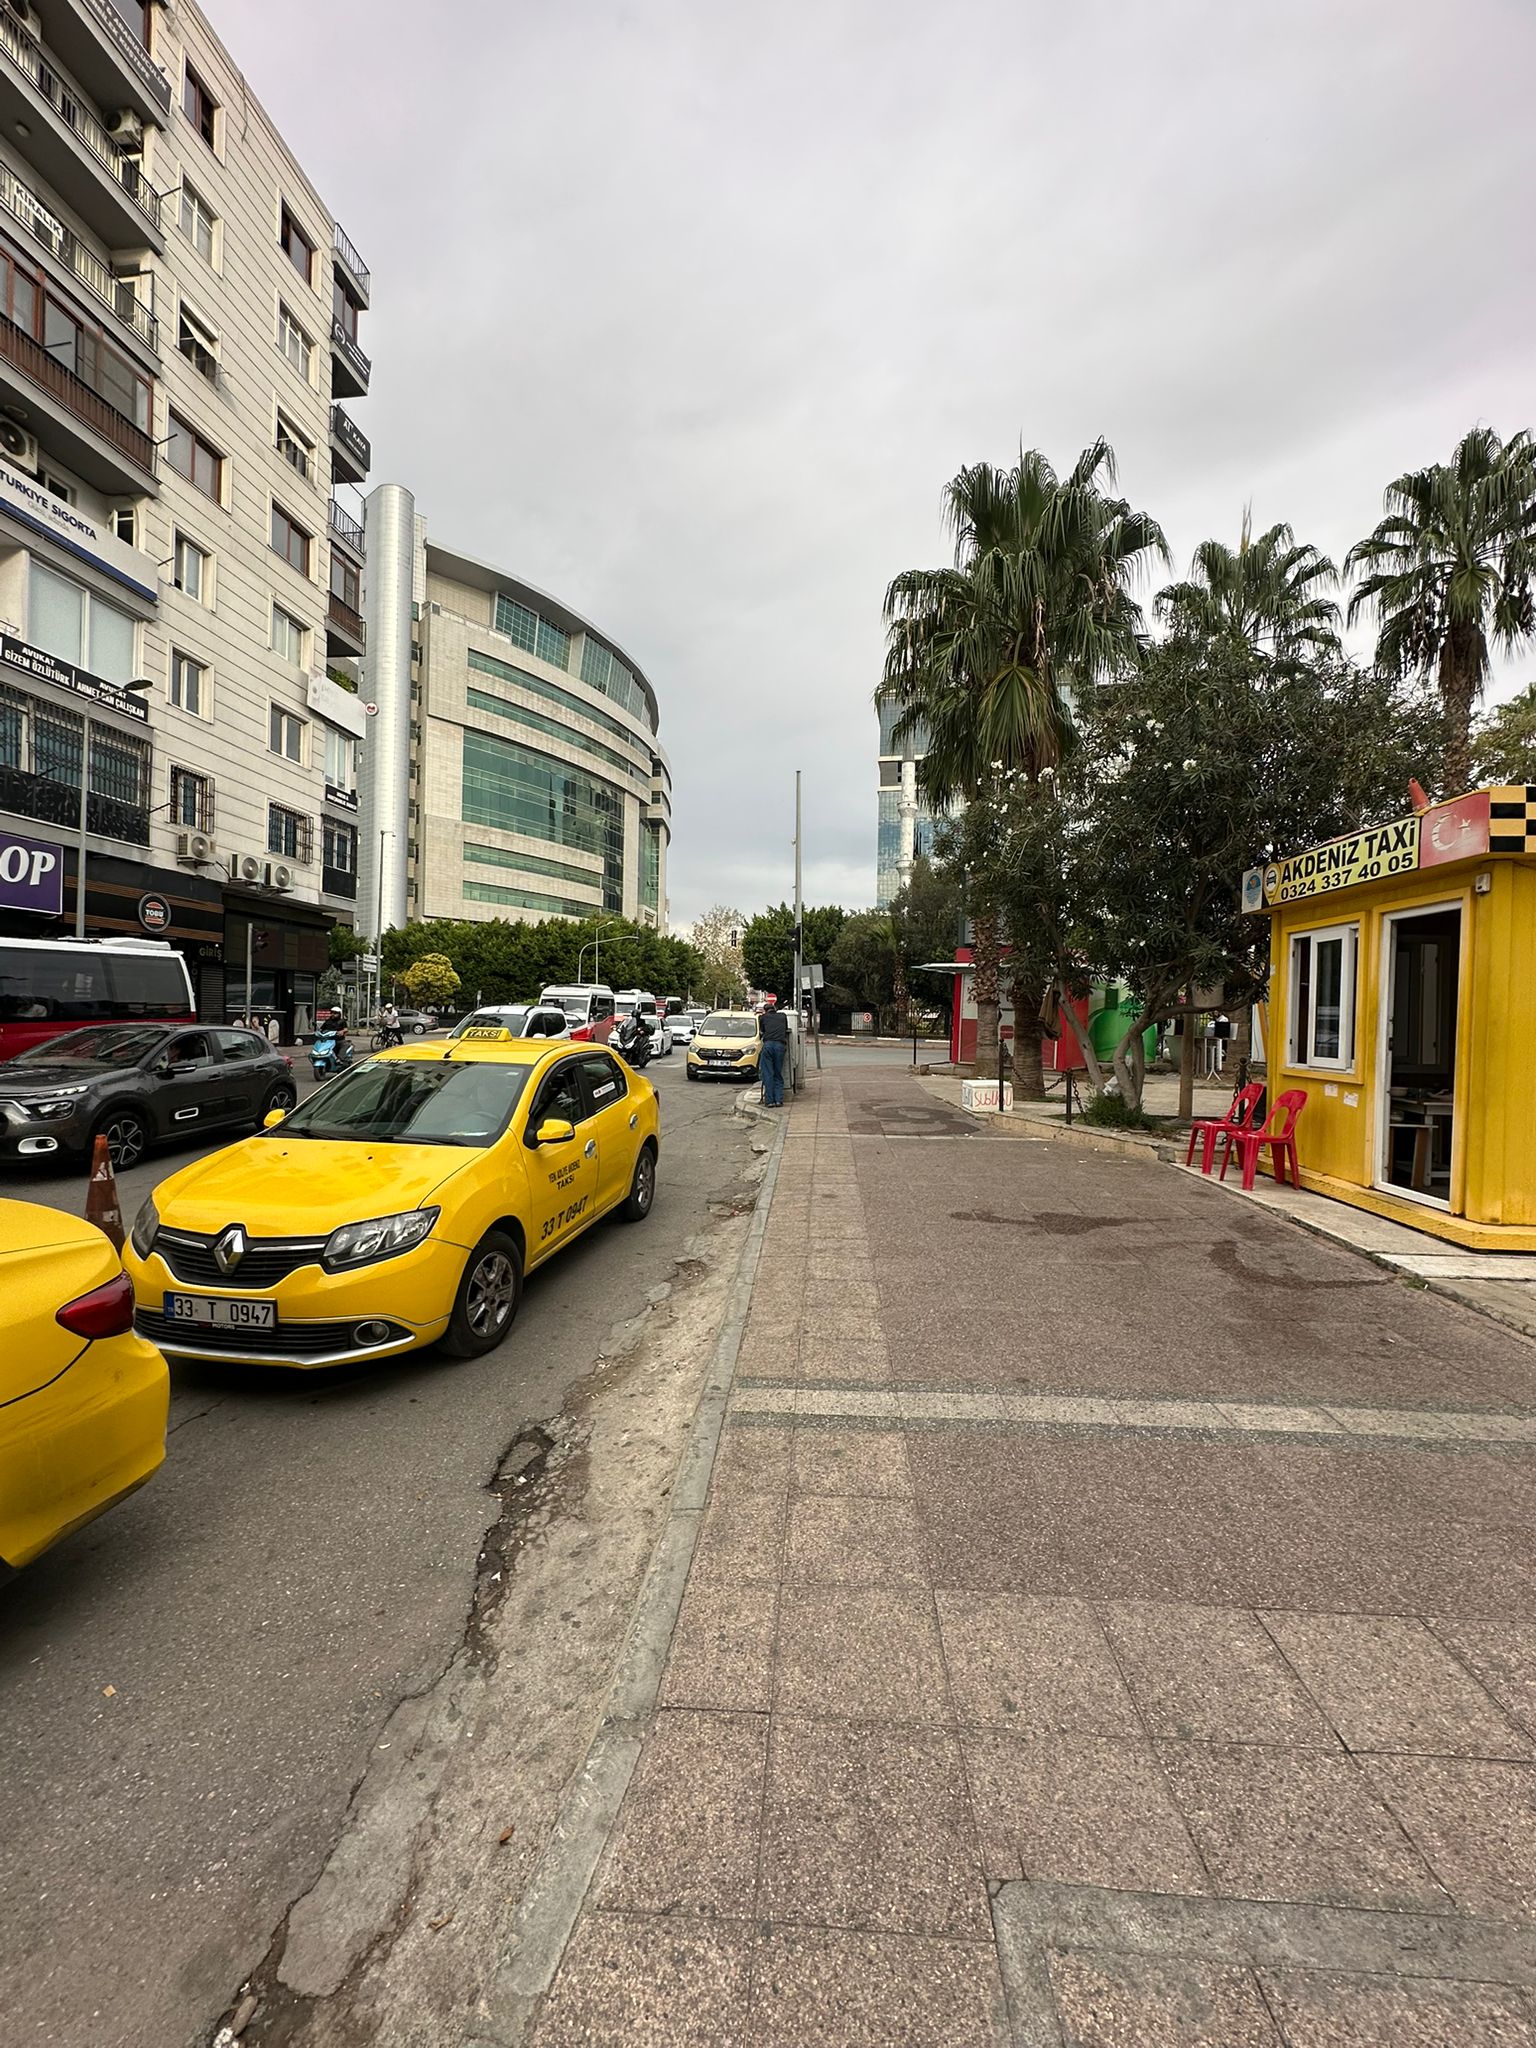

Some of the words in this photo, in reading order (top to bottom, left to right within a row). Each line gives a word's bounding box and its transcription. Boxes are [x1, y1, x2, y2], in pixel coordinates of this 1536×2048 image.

[113, 17, 168, 92] ARABULUCULUK
[4, 649, 31, 669] GİZEM
[31, 659, 71, 686] ÖZLÜTÜRK
[21, 646, 56, 667] AVUKAT
[115, 698, 145, 719] ÇALIŞKAN
[1280, 882, 1317, 901] 0324
[1321, 869, 1353, 891] 337
[1358, 860, 1382, 880] 40
[1387, 851, 1414, 873] 05
[541, 1216, 556, 1241] 33
[557, 1210, 566, 1230] T
[565, 1194, 589, 1224] 0947
[174, 1298, 194, 1318] 33
[207, 1301, 217, 1321] T
[229, 1303, 271, 1325] 0947
